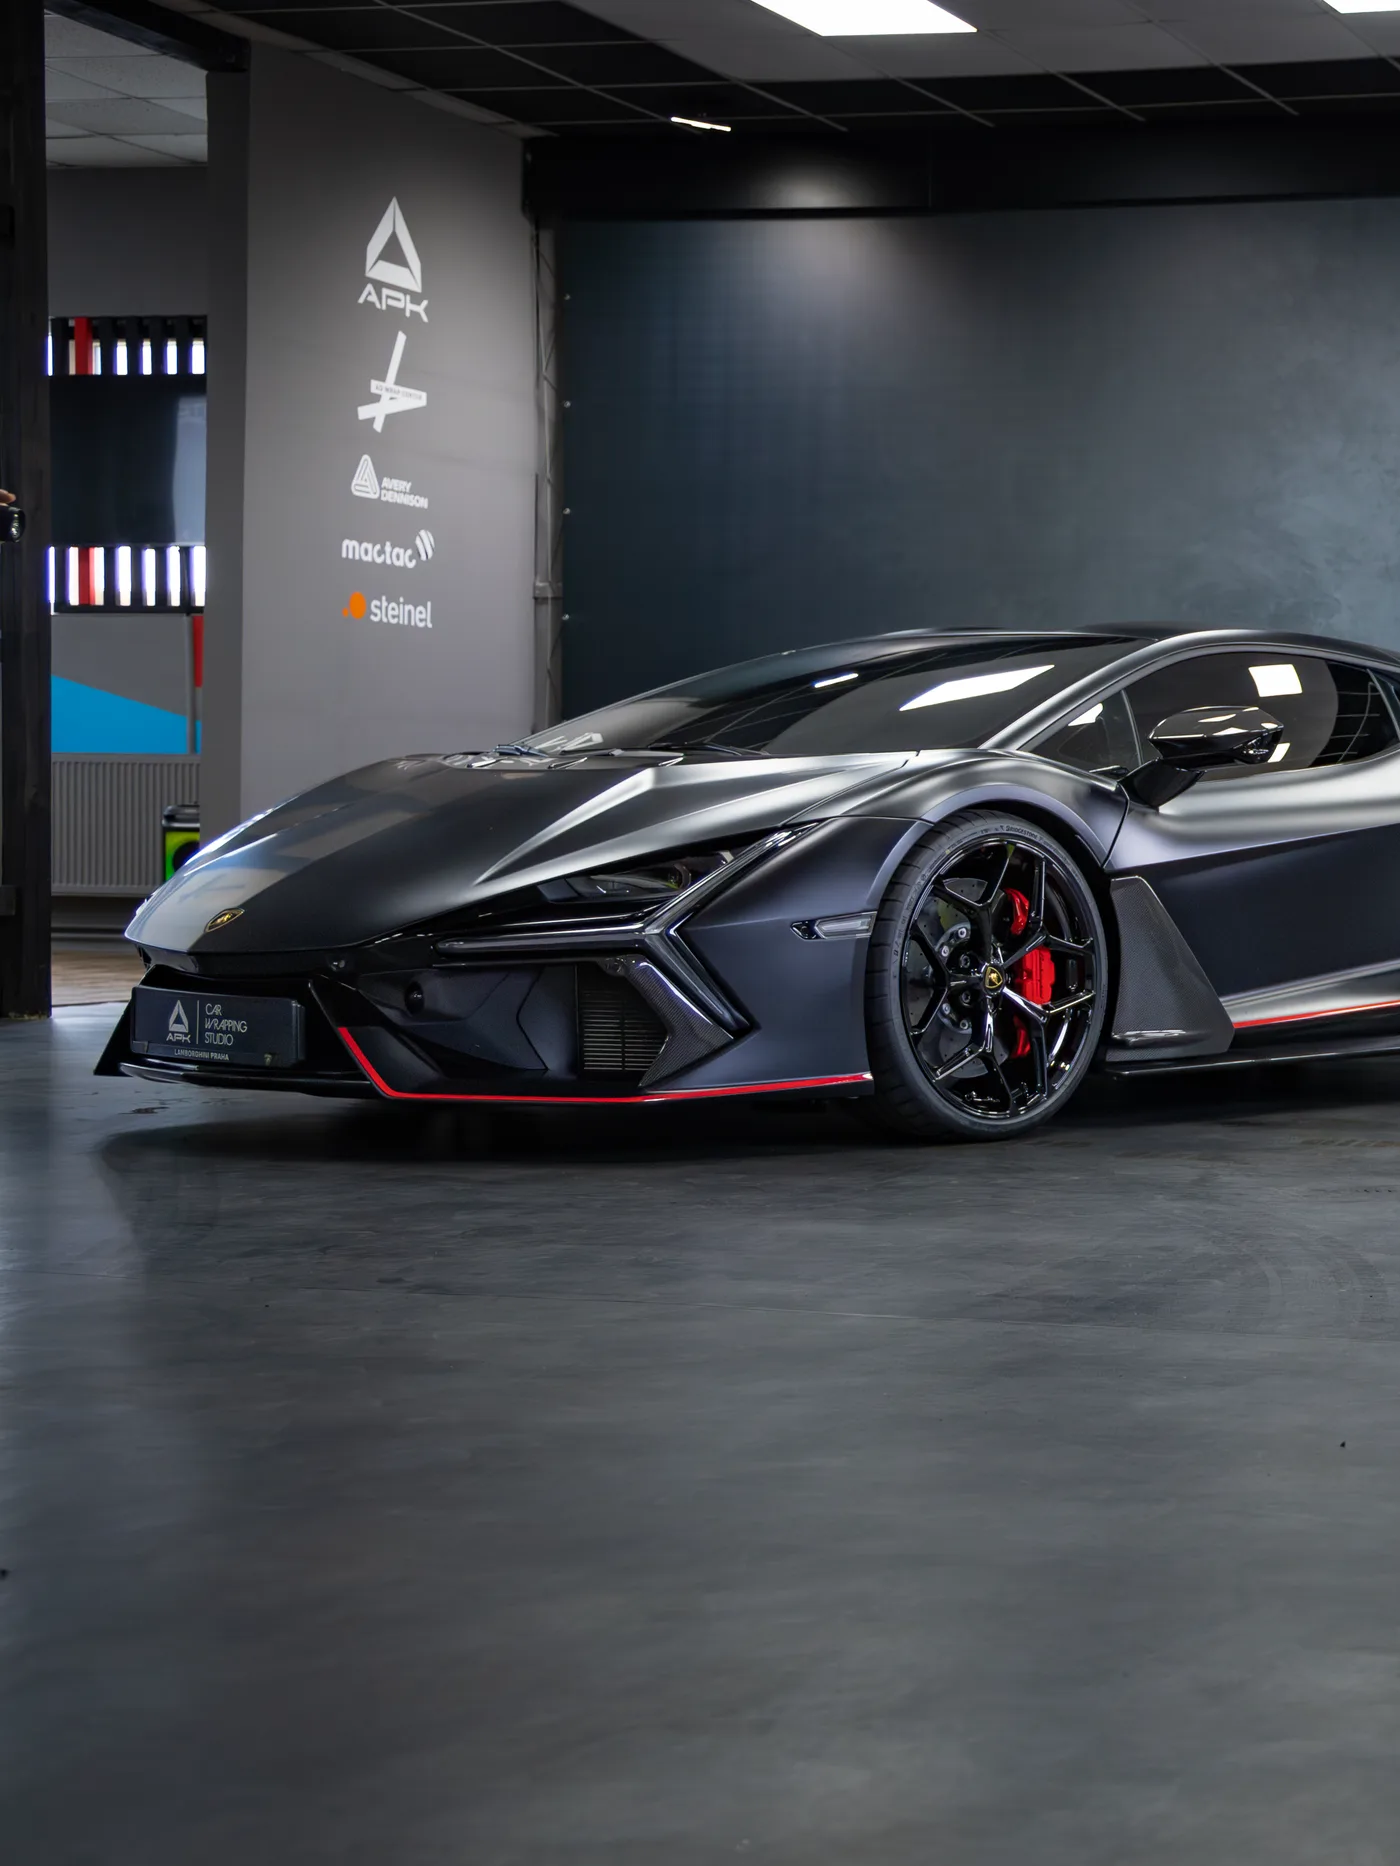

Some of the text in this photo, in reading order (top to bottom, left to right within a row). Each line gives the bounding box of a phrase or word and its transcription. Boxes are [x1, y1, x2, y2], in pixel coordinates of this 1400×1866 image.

[358, 282, 428, 322] APK
[381, 476, 412, 493] AVERY
[380, 489, 429, 509] DENNISON
[341, 538, 417, 568] mactac
[370, 595, 433, 628] steinel
[205, 1003, 223, 1016] CAR
[204, 1018, 248, 1033] WRAPPING
[166, 1033, 191, 1043] APK
[204, 1032, 234, 1046] STUDIO
[174, 1048, 230, 1061] LAMBORGHINI PRAHA
